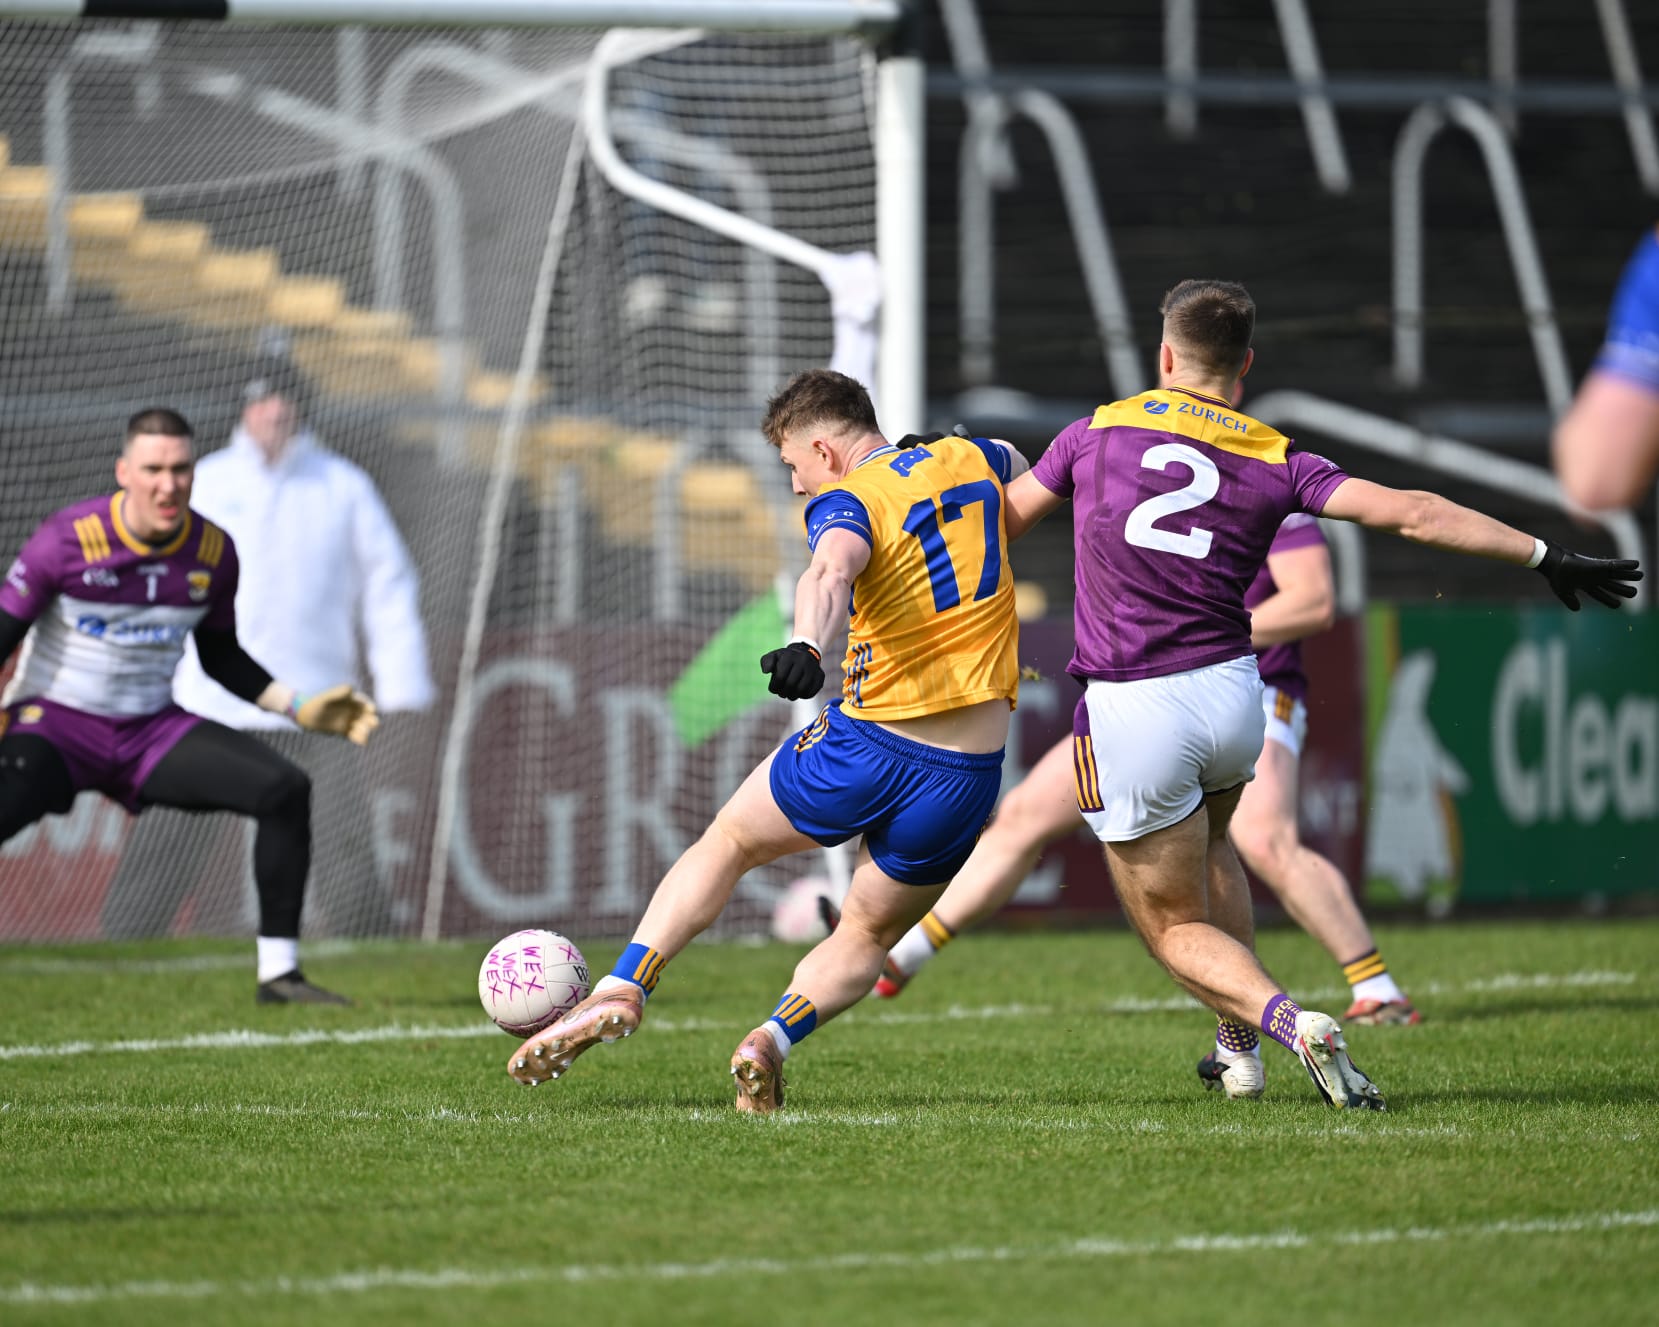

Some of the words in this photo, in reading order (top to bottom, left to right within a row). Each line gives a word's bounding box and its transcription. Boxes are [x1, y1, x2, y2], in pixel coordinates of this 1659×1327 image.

[1176, 401, 1248, 434] ZURICH
[1124, 442, 1221, 560] 2
[901, 478, 1001, 614] 17
[1490, 640, 1659, 828] Clea
[486, 949, 504, 1007] WEX
[502, 952, 522, 1002] WEX
[522, 945, 545, 996] WEX
